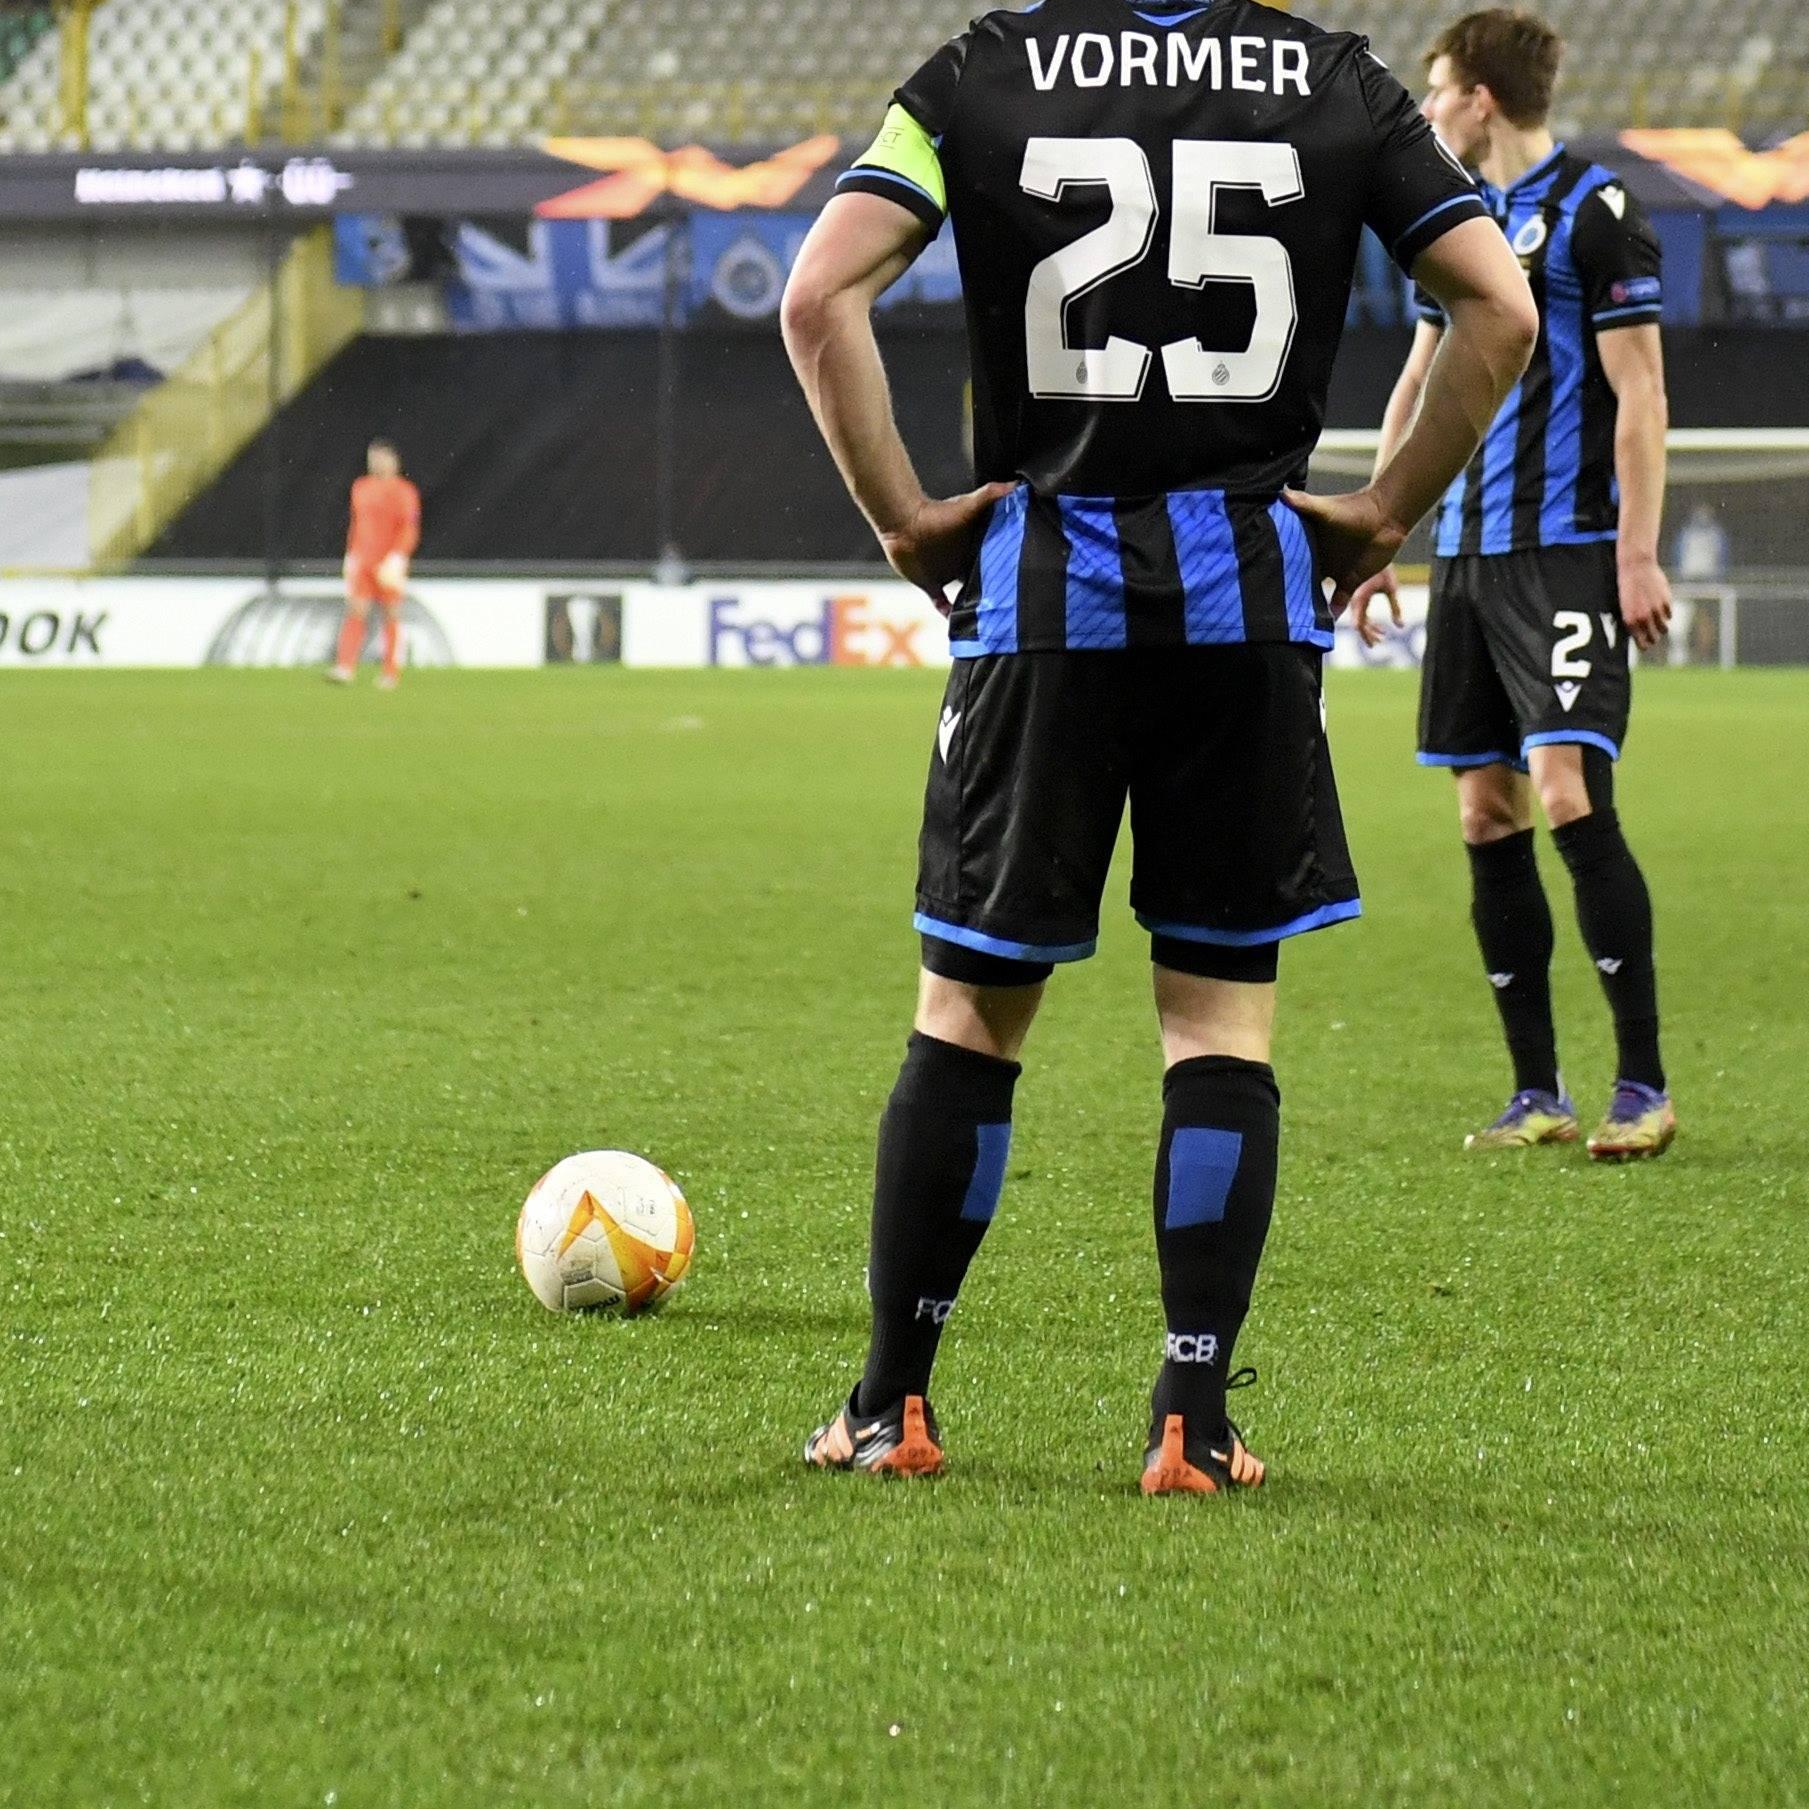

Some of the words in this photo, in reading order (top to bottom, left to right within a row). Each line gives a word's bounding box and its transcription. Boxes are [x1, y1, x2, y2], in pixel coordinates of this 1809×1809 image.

[1024, 31, 1312, 97] VORMER
[1019, 136, 1306, 403] 25
[706, 596, 923, 667] FedEx
